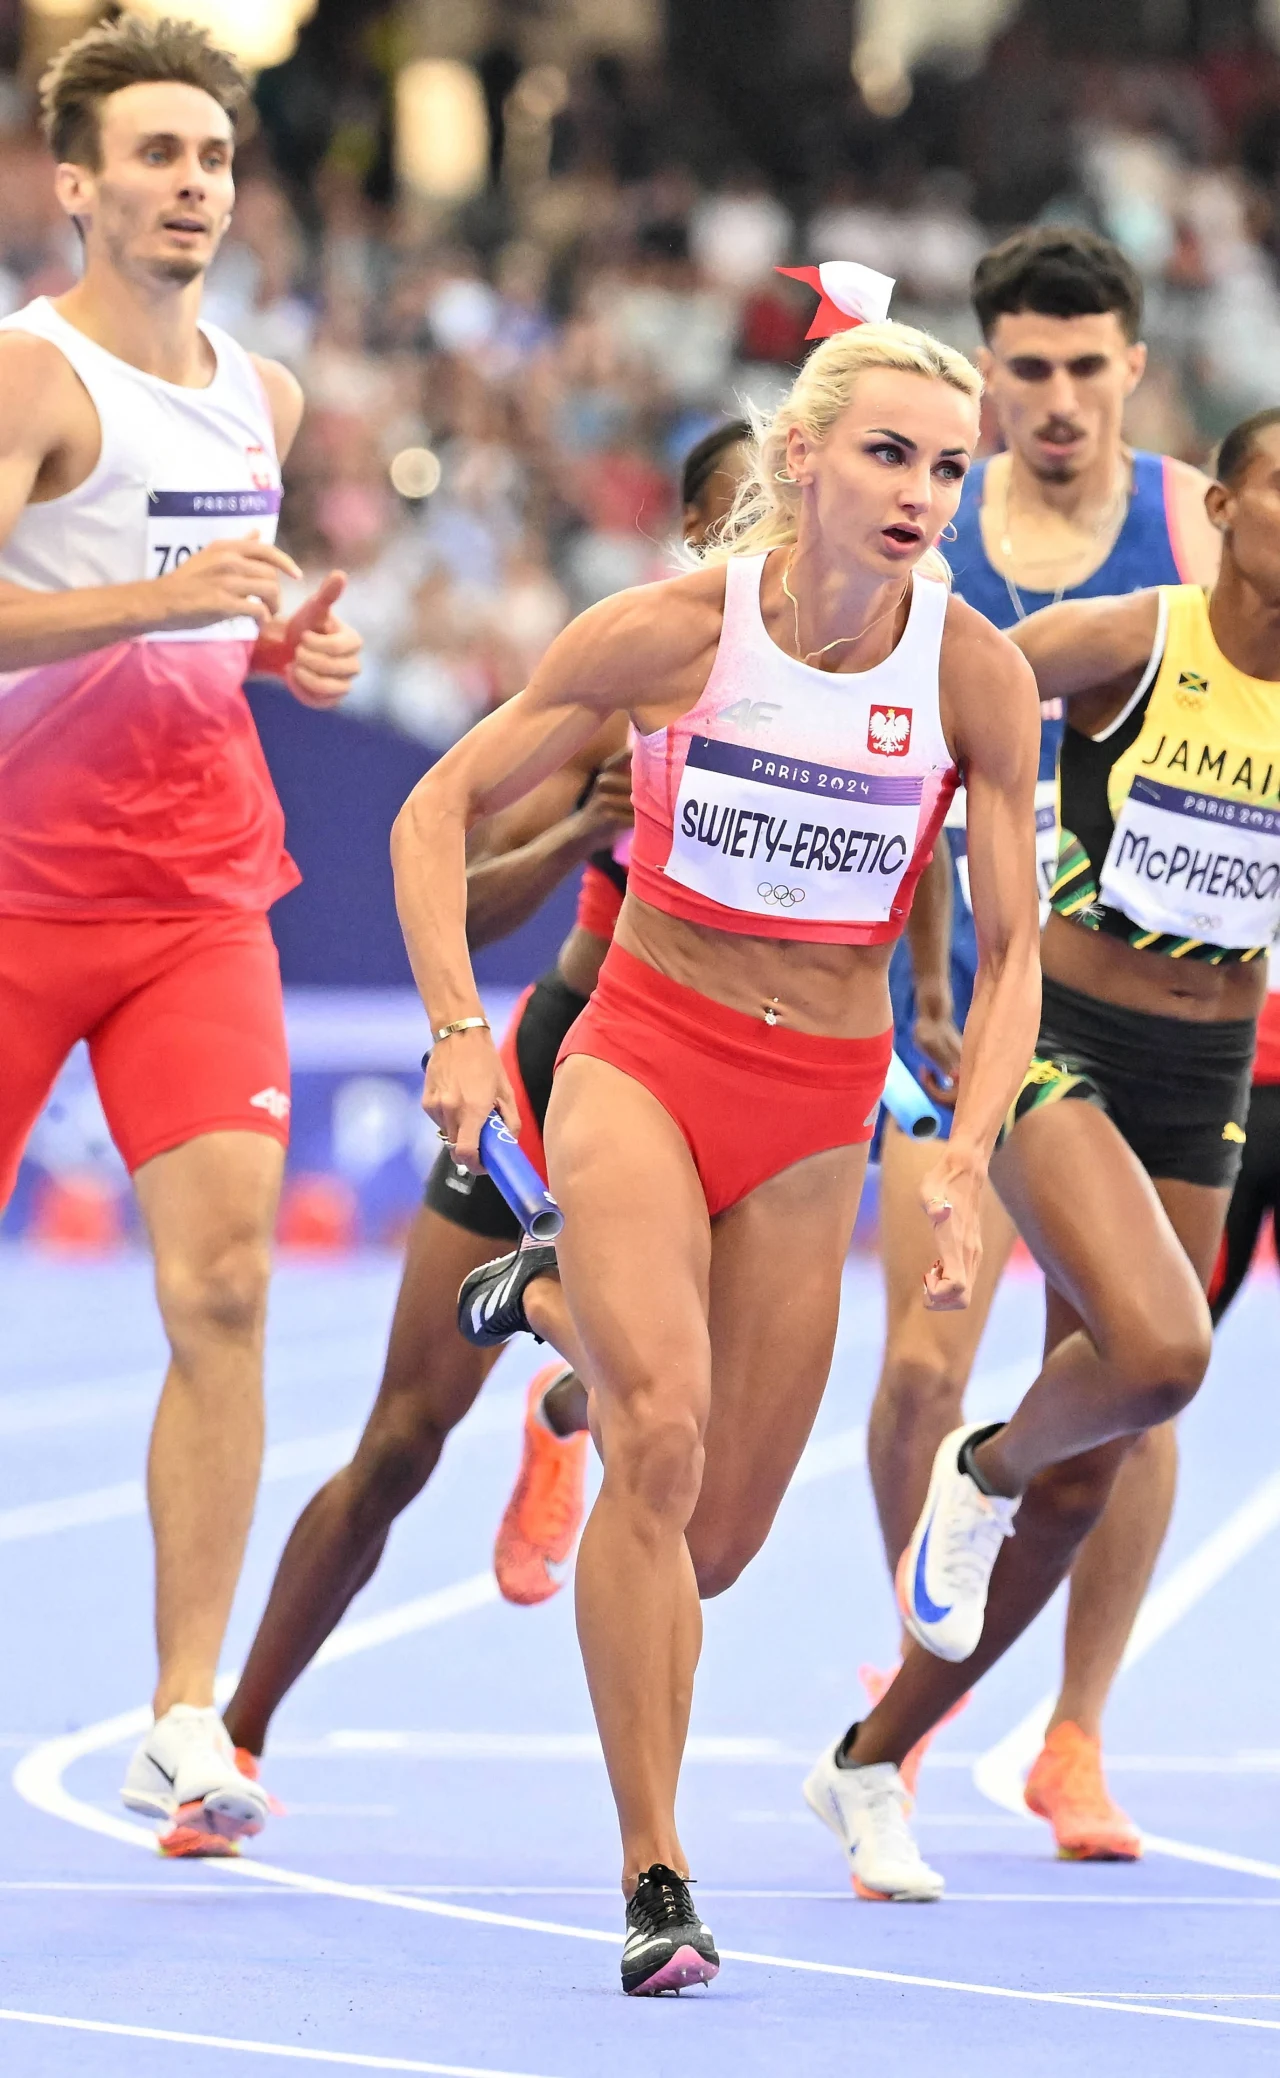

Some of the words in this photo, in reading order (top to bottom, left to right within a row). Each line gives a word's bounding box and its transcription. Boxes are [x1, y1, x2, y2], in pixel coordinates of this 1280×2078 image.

[751, 758, 811, 784] PARIS
[818, 773, 870, 796] 2024
[1141, 735, 1280, 803] JAMAI
[1183, 795, 1235, 821] PARIS
[681, 797, 907, 875] SWIETY-ERSETIC
